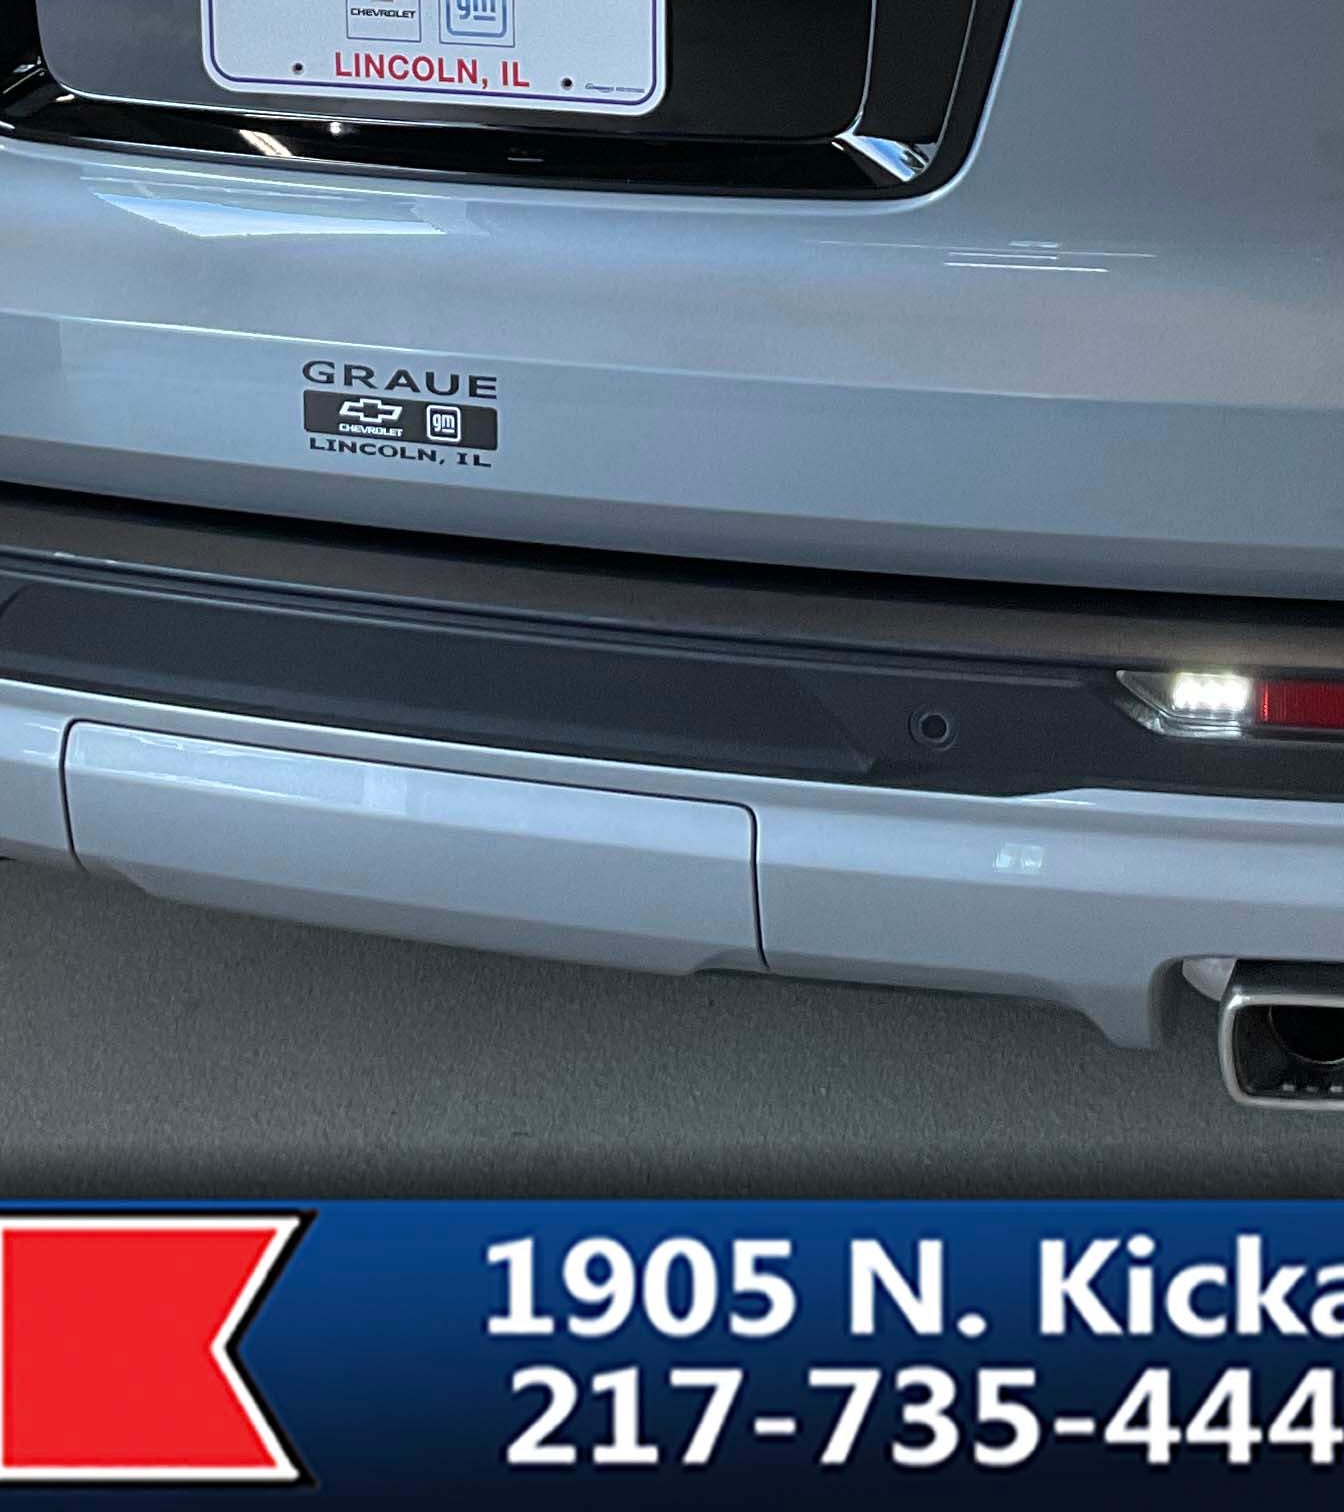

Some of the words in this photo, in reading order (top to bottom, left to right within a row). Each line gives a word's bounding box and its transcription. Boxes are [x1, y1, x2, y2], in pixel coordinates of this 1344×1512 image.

[350, 7, 416, 20] CHEVROLET
[335, 51, 489, 90] LINCOLN,
[501, 61, 531, 88] IL
[302, 360, 498, 400] GRAUE
[339, 423, 403, 437] CHEVROLET
[432, 412, 456, 433] gm
[309, 437, 445, 465] LINCOLN,
[457, 452, 492, 468] IL
